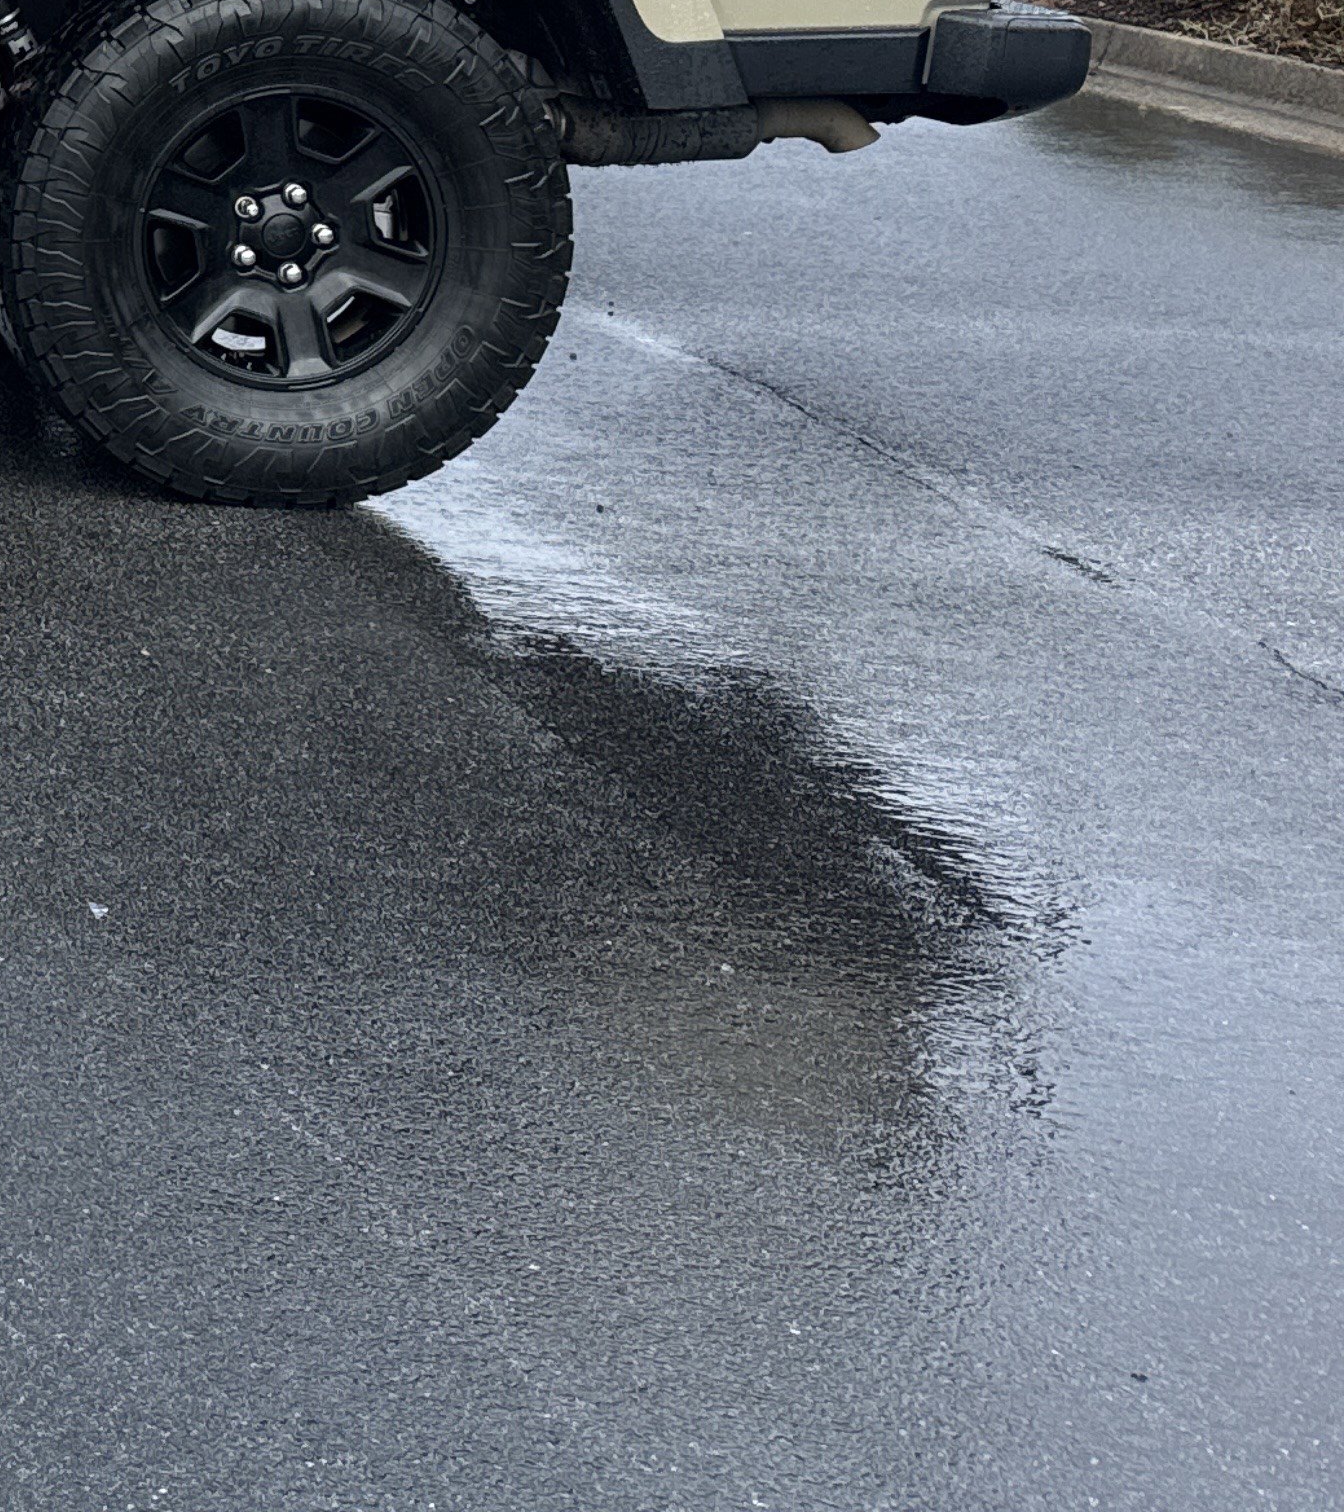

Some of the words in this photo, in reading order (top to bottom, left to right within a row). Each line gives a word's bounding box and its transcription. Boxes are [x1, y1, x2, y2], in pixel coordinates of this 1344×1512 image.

[169, 35, 285, 95] TOYO
[386, 324, 480, 420] OPEN
[180, 399, 380, 443] COUNTRY
